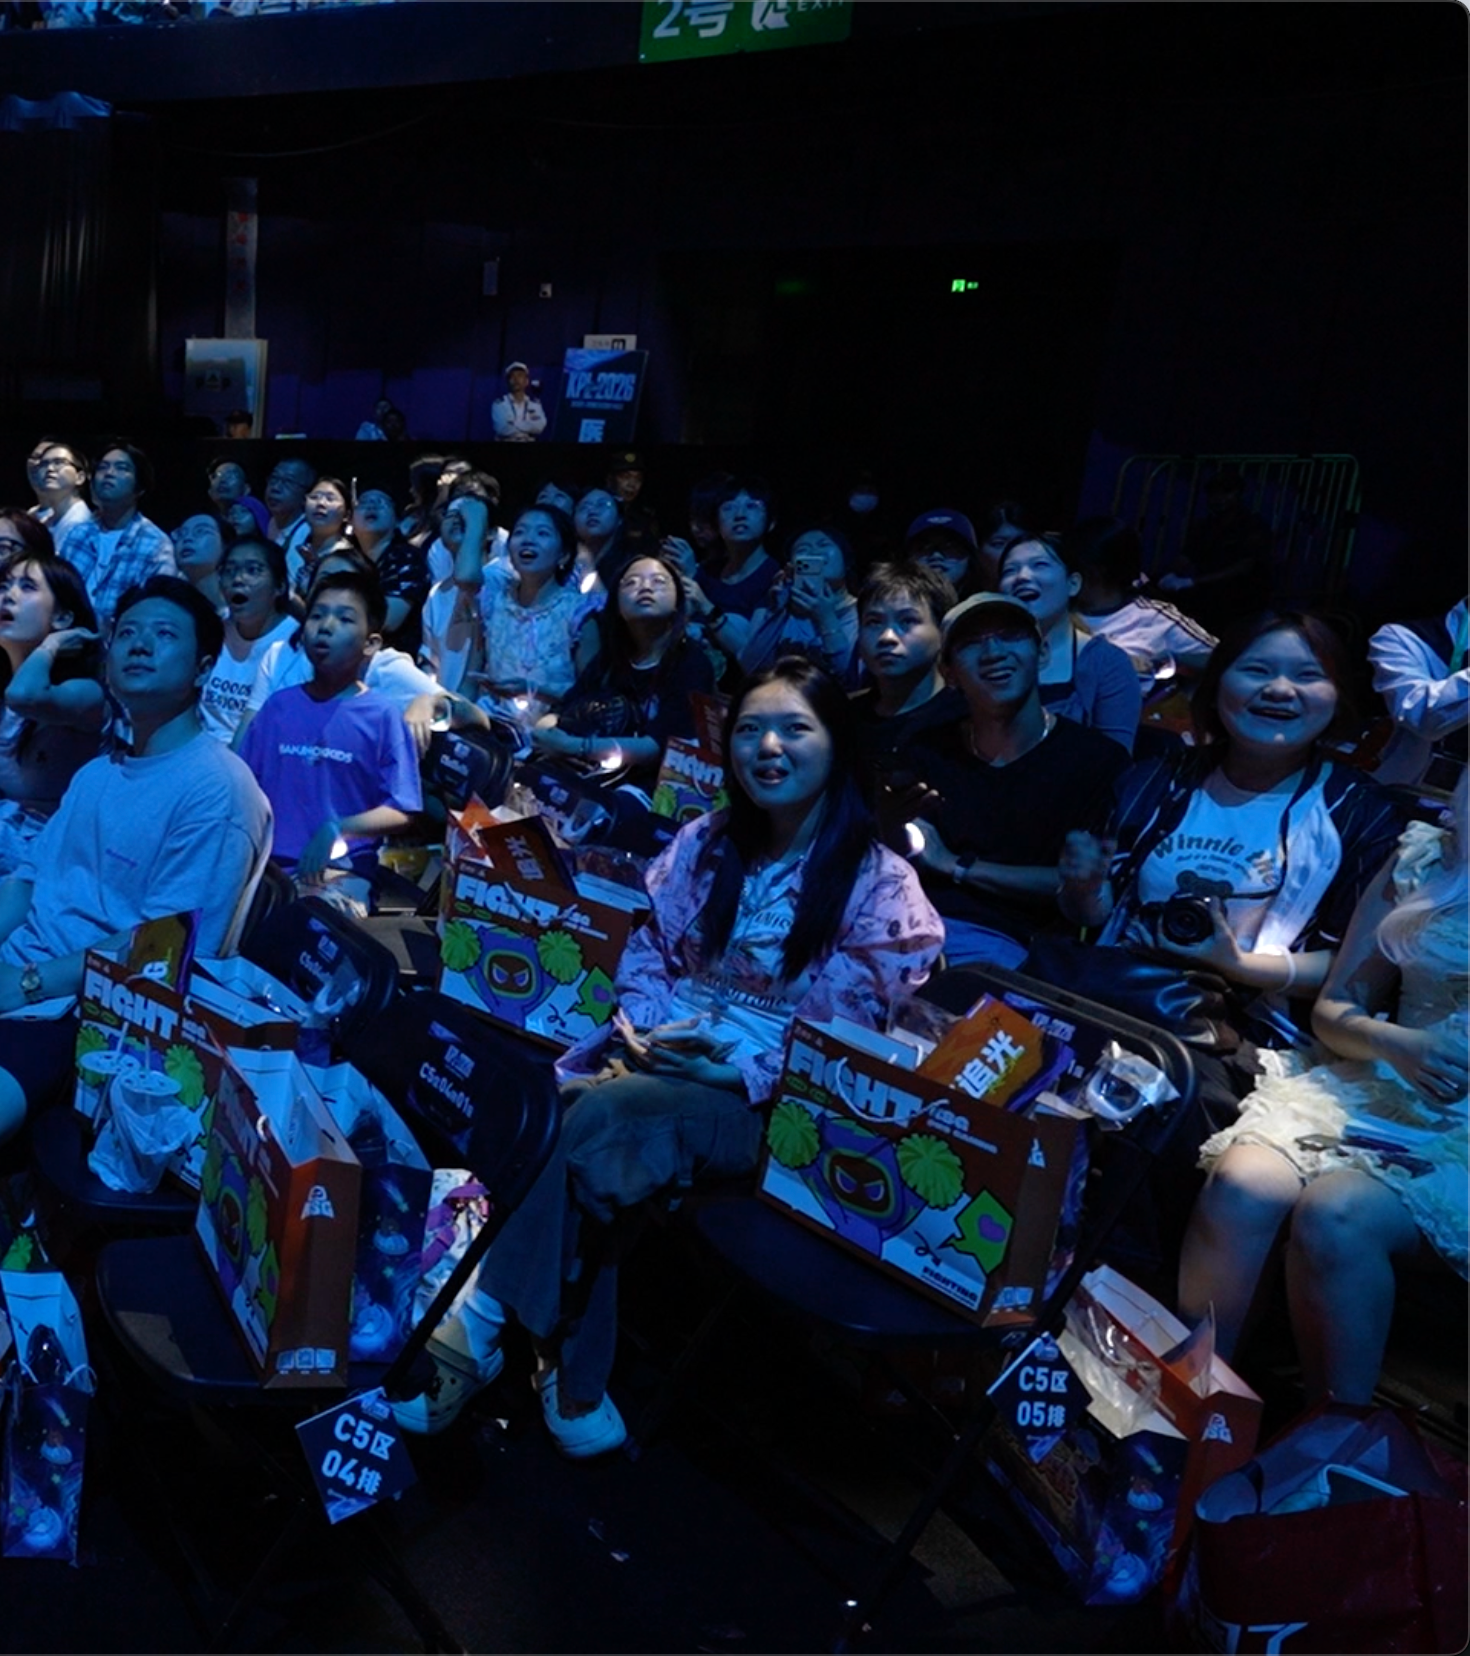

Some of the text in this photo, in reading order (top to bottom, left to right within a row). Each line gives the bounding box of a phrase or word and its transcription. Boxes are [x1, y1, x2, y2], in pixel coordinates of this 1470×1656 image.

[1154, 833, 1245, 859] Winnie
[455, 873, 560, 929] FIGHT
[84, 967, 180, 1041] FIGHT
[788, 1037, 924, 1139] FIGHT
[951, 1029, 1026, 1100] 追光
[1018, 1365, 1070, 1394] C5区
[333, 1411, 396, 1462] C5区
[1016, 1400, 1067, 1428] 05排
[321, 1448, 383, 1497] 04排
